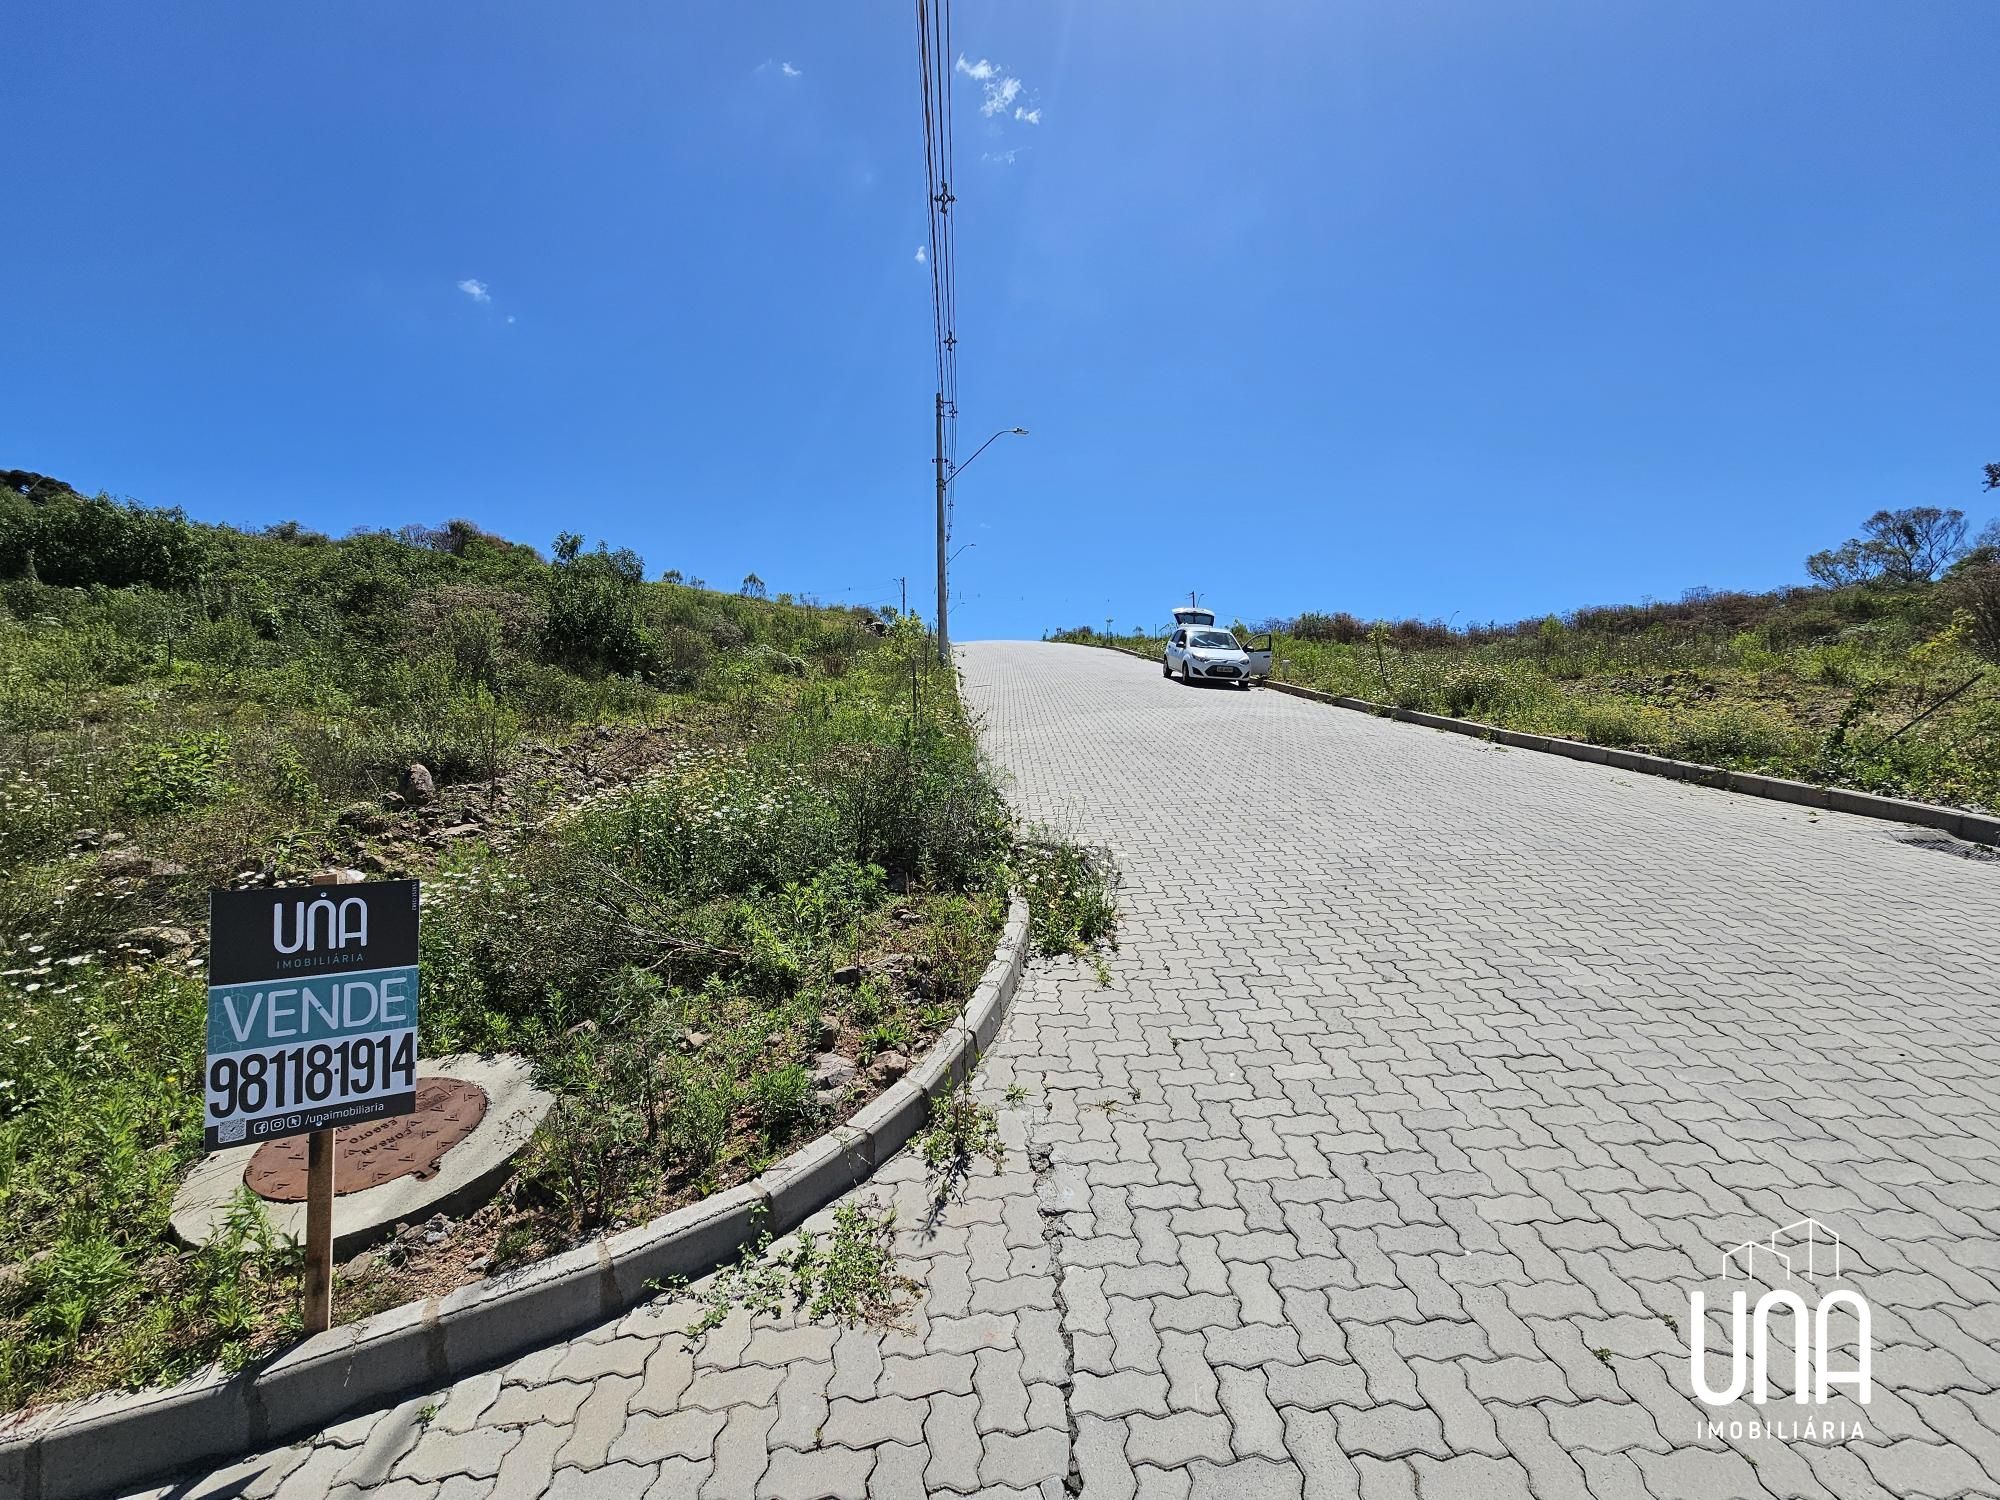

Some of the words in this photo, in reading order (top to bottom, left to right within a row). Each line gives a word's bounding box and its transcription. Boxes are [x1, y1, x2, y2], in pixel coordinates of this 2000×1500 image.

[273, 897, 368, 954] UNA
[276, 953, 364, 969] IMOBILIÁRIA
[223, 977, 407, 1042] VENDE
